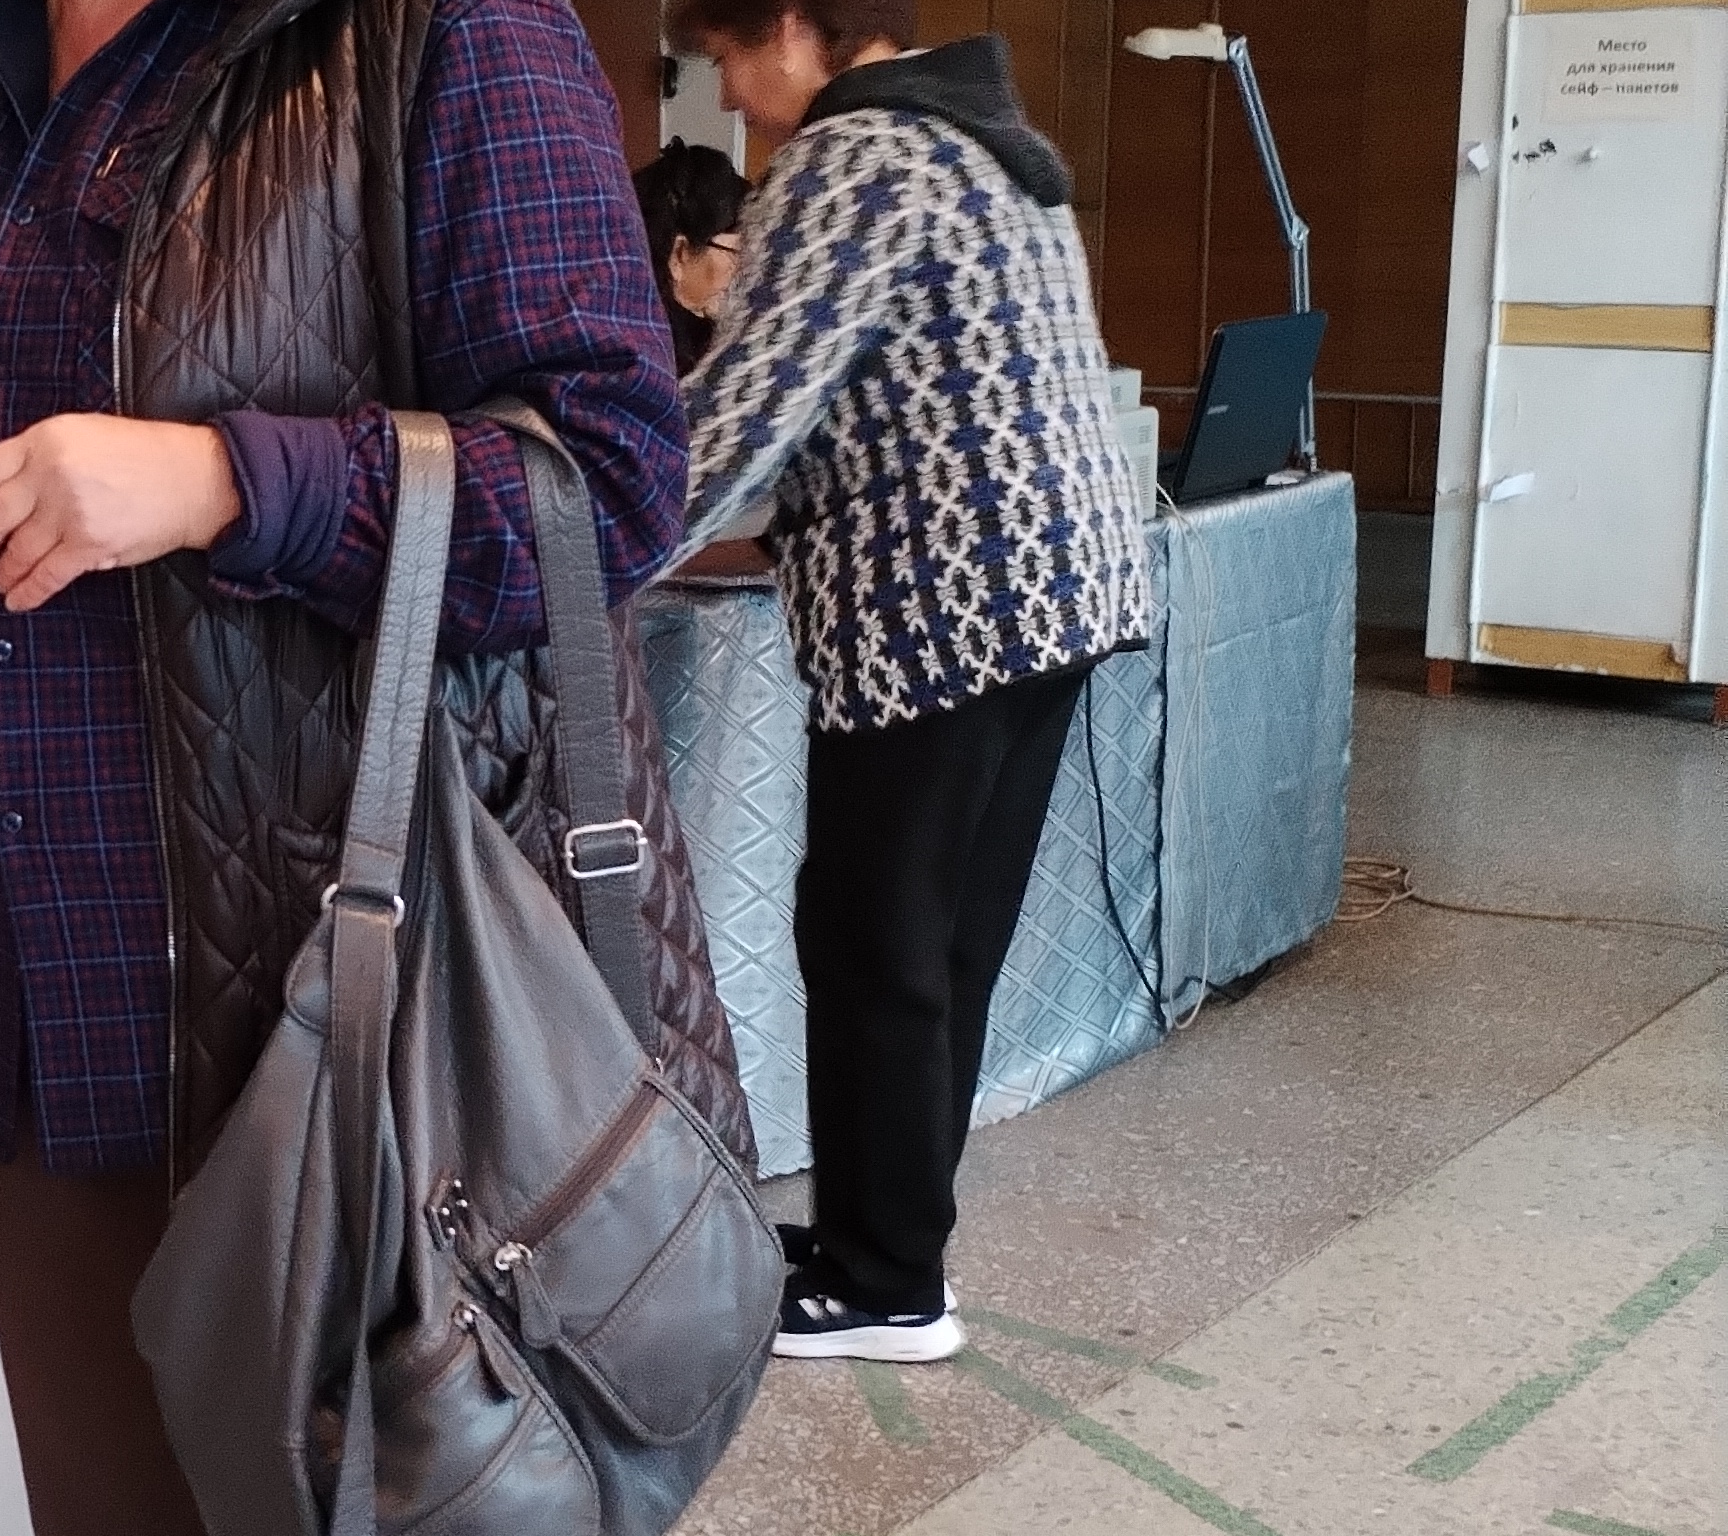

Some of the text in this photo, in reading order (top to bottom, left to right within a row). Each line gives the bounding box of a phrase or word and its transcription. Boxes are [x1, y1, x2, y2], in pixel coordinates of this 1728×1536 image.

[1597, 38, 1648, 52] Место
[1566, 61, 1675, 77] для хранения
[1559, 80, 1599, 96] сейф
[1615, 81, 1679, 95] пакетов
